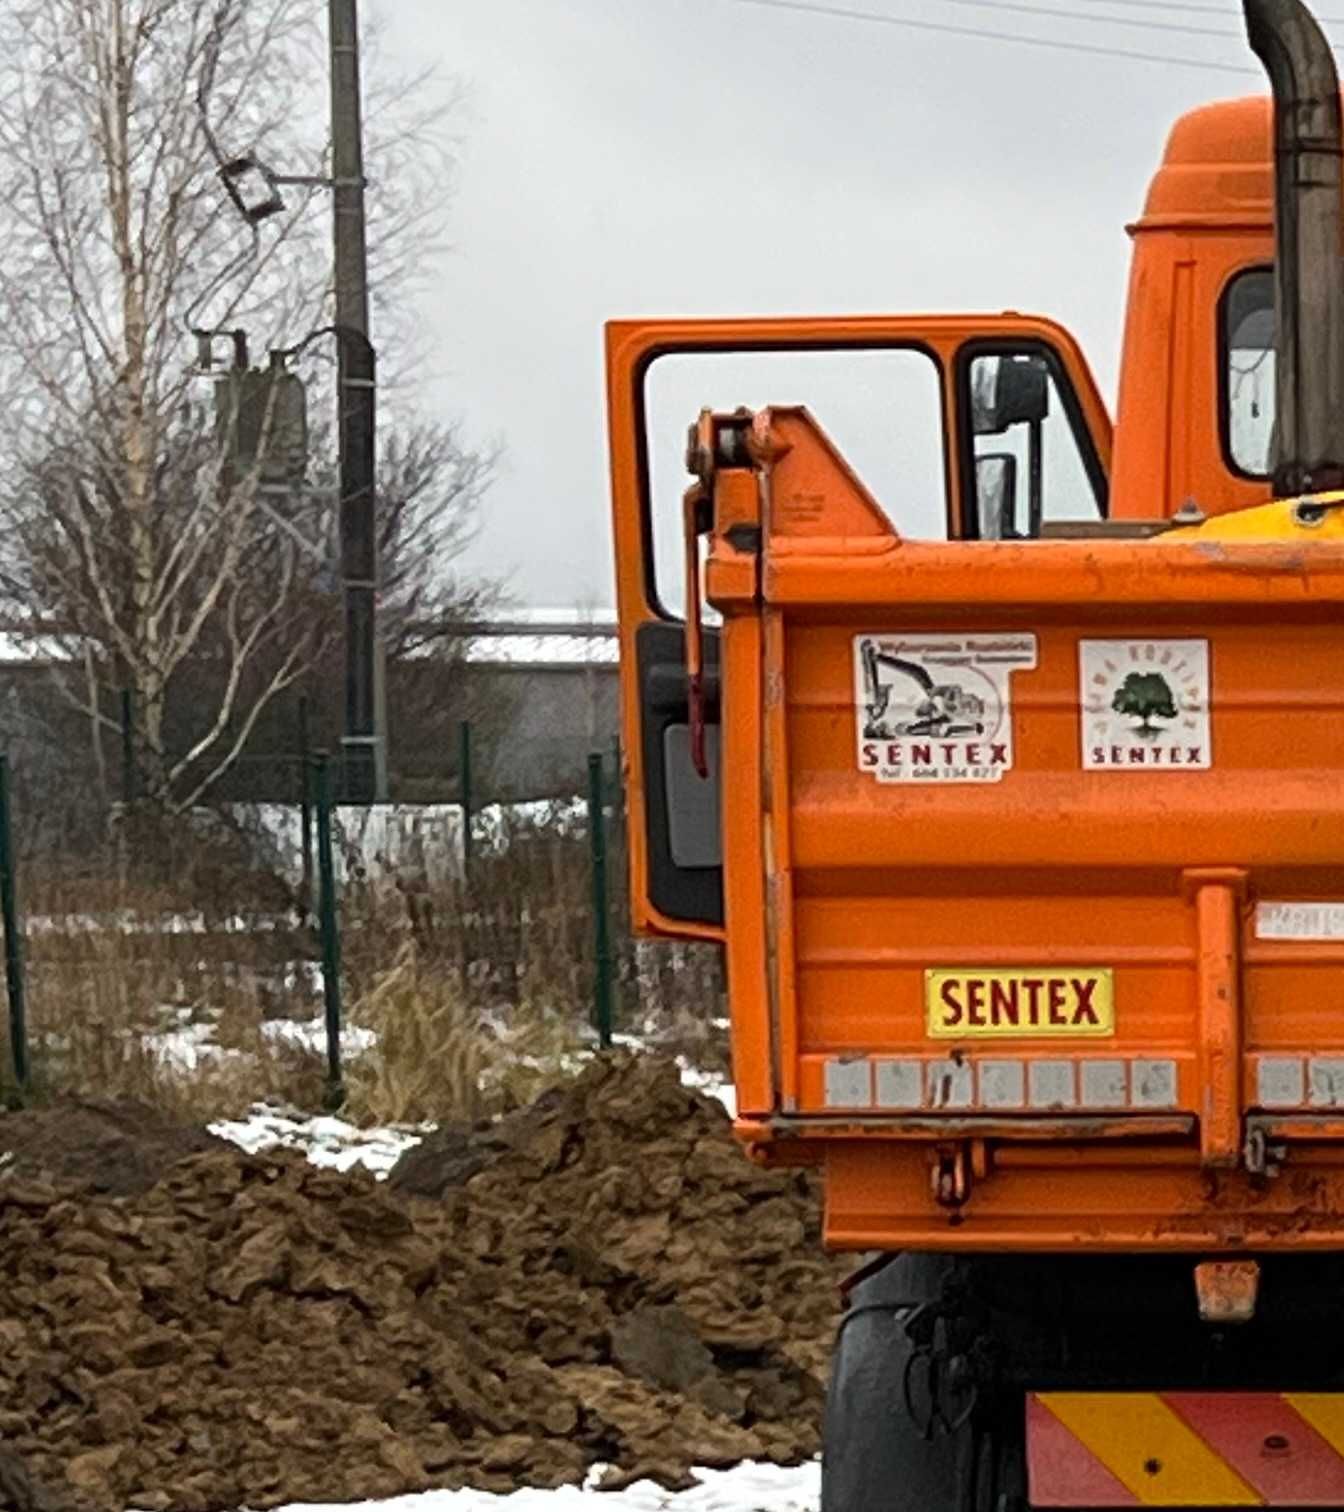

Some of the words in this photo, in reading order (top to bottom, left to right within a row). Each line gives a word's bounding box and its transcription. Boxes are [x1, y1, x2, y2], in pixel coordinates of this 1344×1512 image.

[863, 743, 1007, 766] SENTEX
[1092, 745, 1201, 764] SENTEX
[939, 978, 1100, 1026] SENTEX
